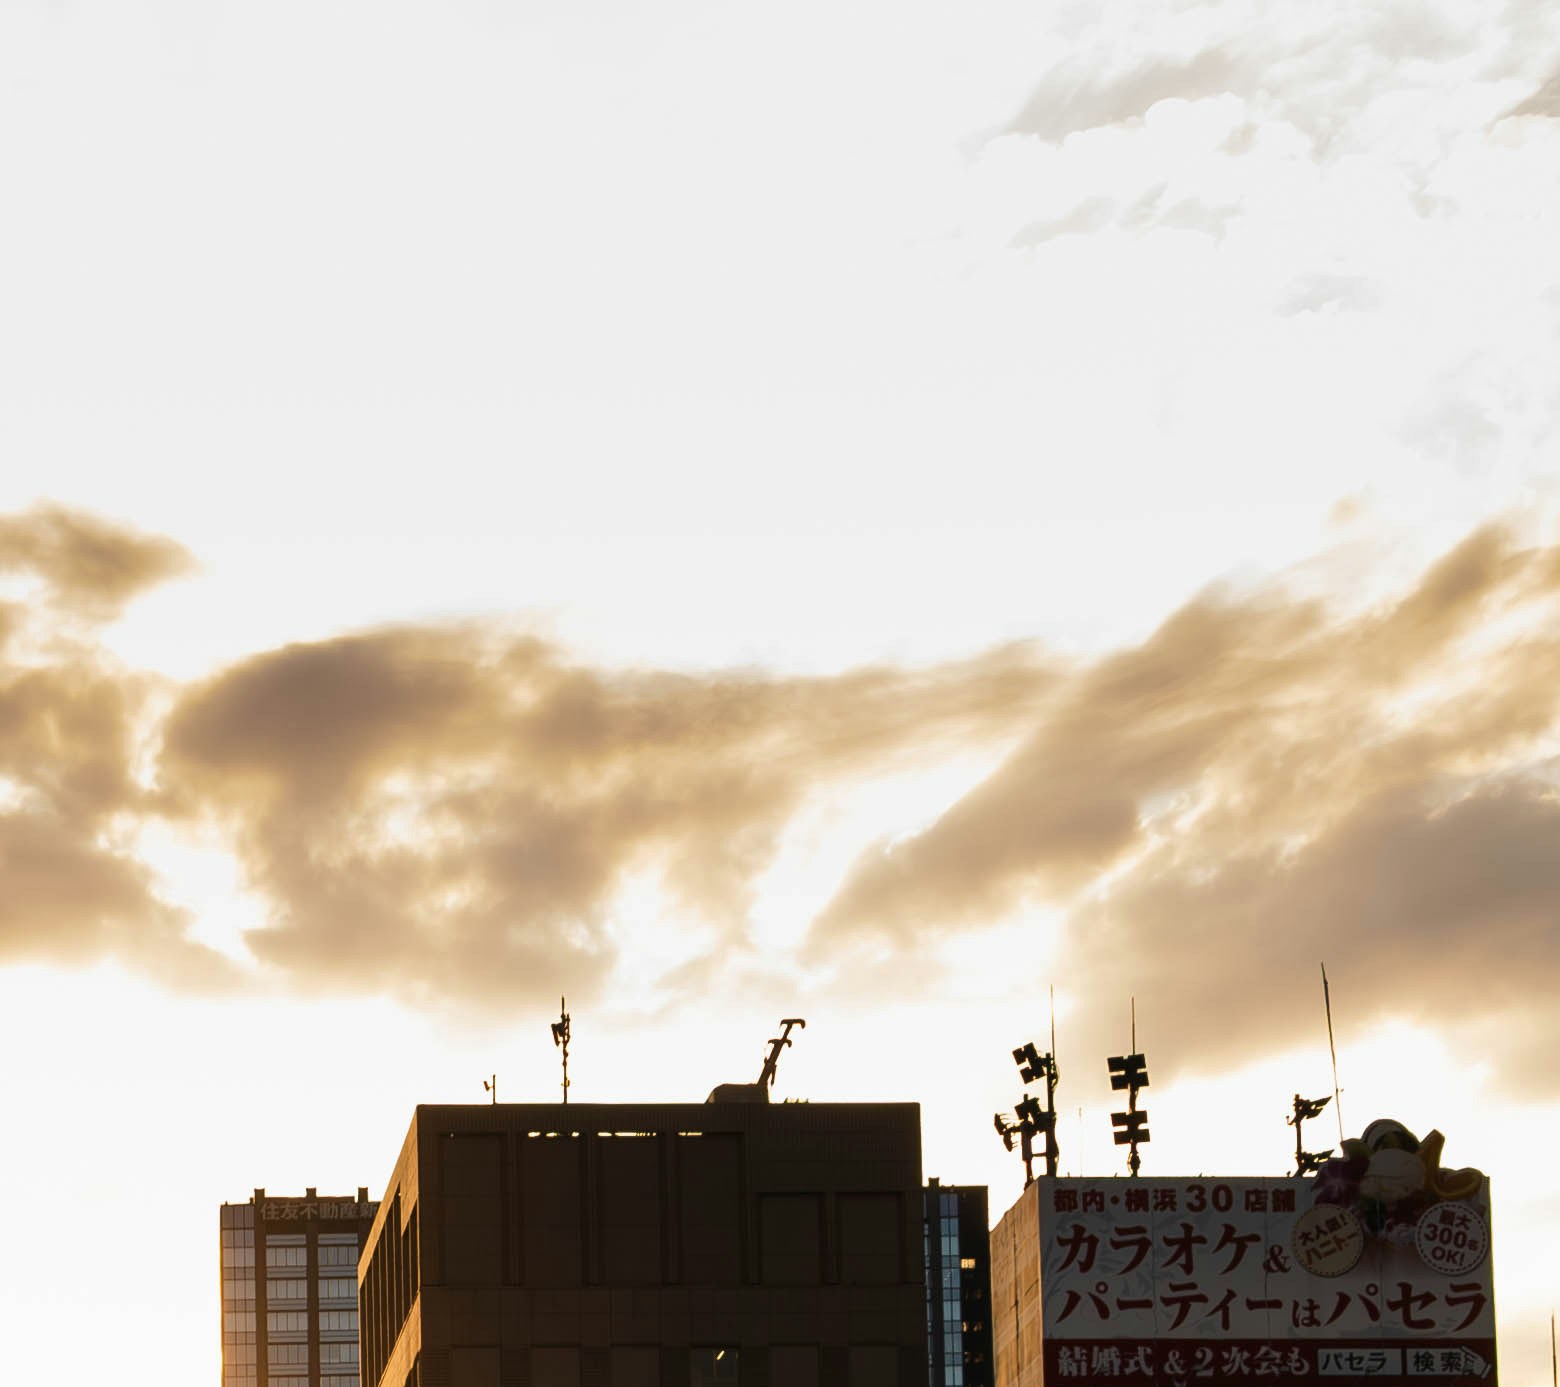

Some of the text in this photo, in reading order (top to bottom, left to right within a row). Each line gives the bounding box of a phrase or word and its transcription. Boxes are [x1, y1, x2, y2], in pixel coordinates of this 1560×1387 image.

[1055, 1282, 1488, 1331] パーティーはパセラ
